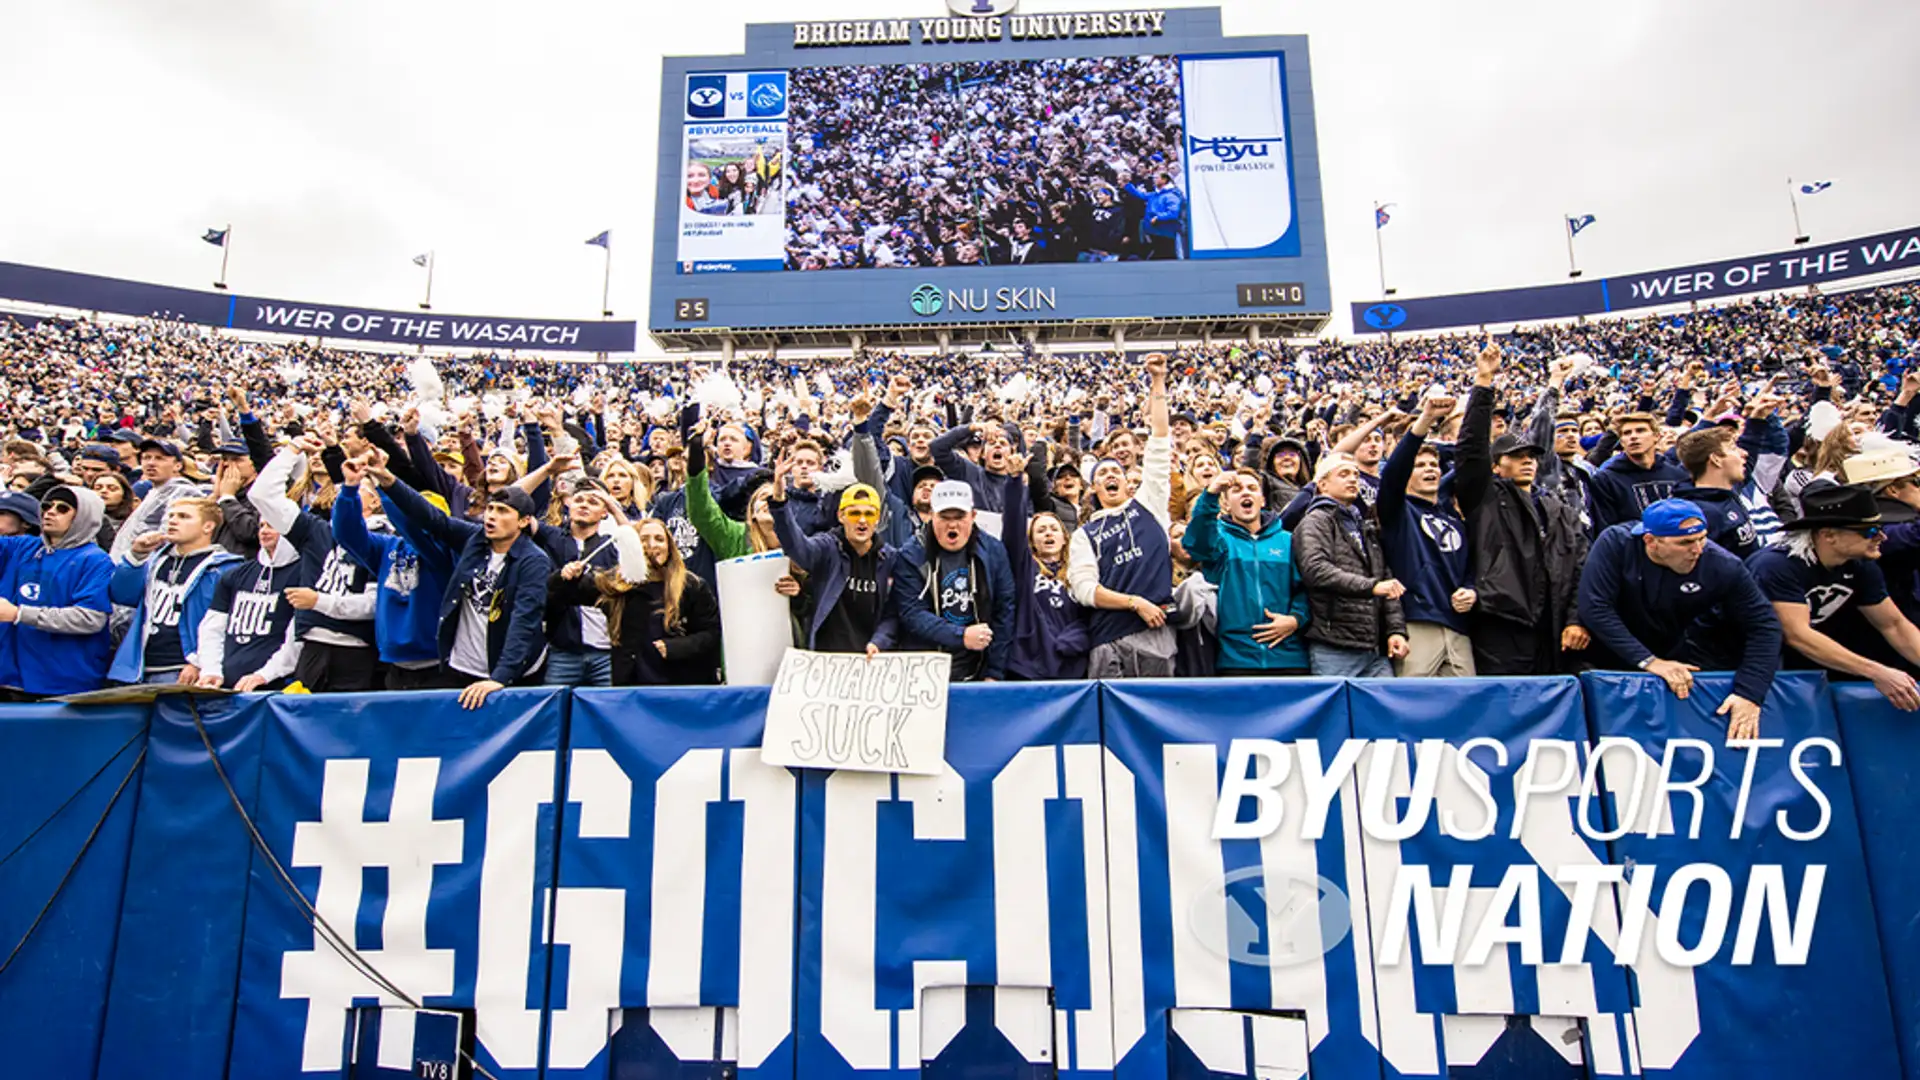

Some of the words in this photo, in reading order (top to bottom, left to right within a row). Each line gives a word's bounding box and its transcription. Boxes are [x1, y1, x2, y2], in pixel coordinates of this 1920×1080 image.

[794, 21, 911, 47] BRIGHAM
[919, 17, 1002, 43] YOUNG
[1010, 12, 1165, 40] UNIVERSITY
[688, 125, 783, 135] #BYUFOOTBALL
[1213, 137, 1268, 162] byu
[1723, 262, 1771, 286] OF
[1779, 249, 1850, 280] THE
[948, 288, 988, 311] NU
[995, 286, 1056, 311] SKIN
[1247, 286, 1302, 303] 11:40
[679, 302, 705, 317] 25
[341, 313, 384, 333] OF
[390, 317, 444, 339] THE
[451, 321, 580, 345] WASATCH
[778, 653, 947, 710] POTATOES
[791, 702, 913, 768] SUCK
[421, 1061, 438, 1080] TV
[439, 1062, 448, 1080] 8
